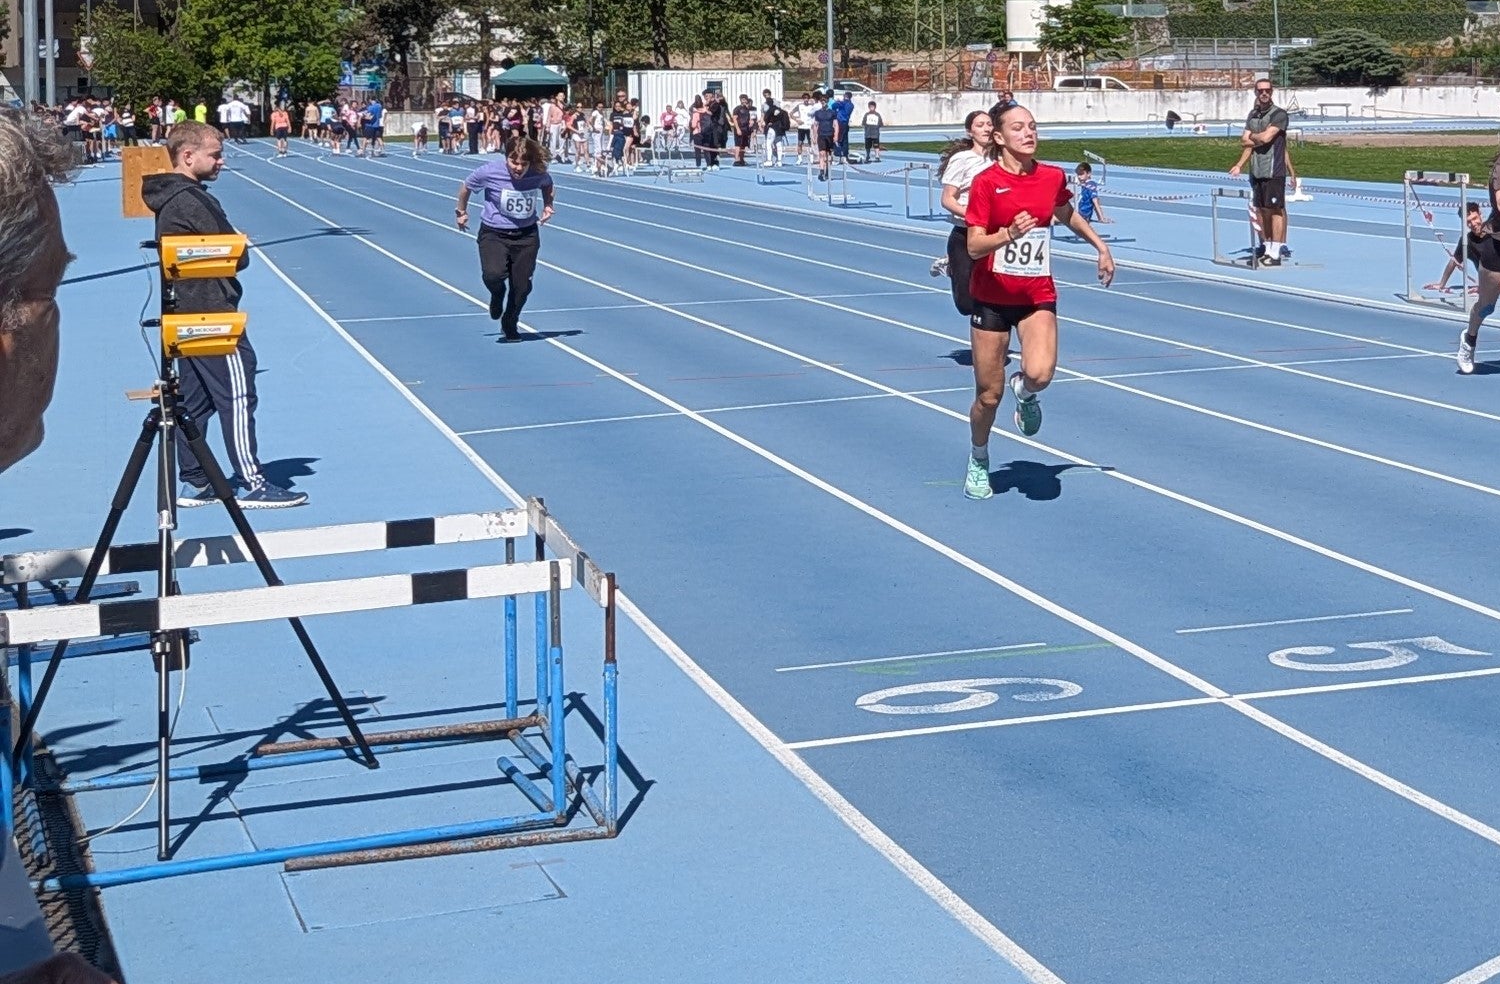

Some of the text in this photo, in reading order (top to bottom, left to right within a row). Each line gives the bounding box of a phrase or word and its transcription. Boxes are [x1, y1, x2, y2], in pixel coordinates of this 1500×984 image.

[506, 198, 533, 213] 659
[1004, 240, 1045, 265] 694
[1268, 636, 1490, 671] 5
[855, 677, 1083, 714] 6
